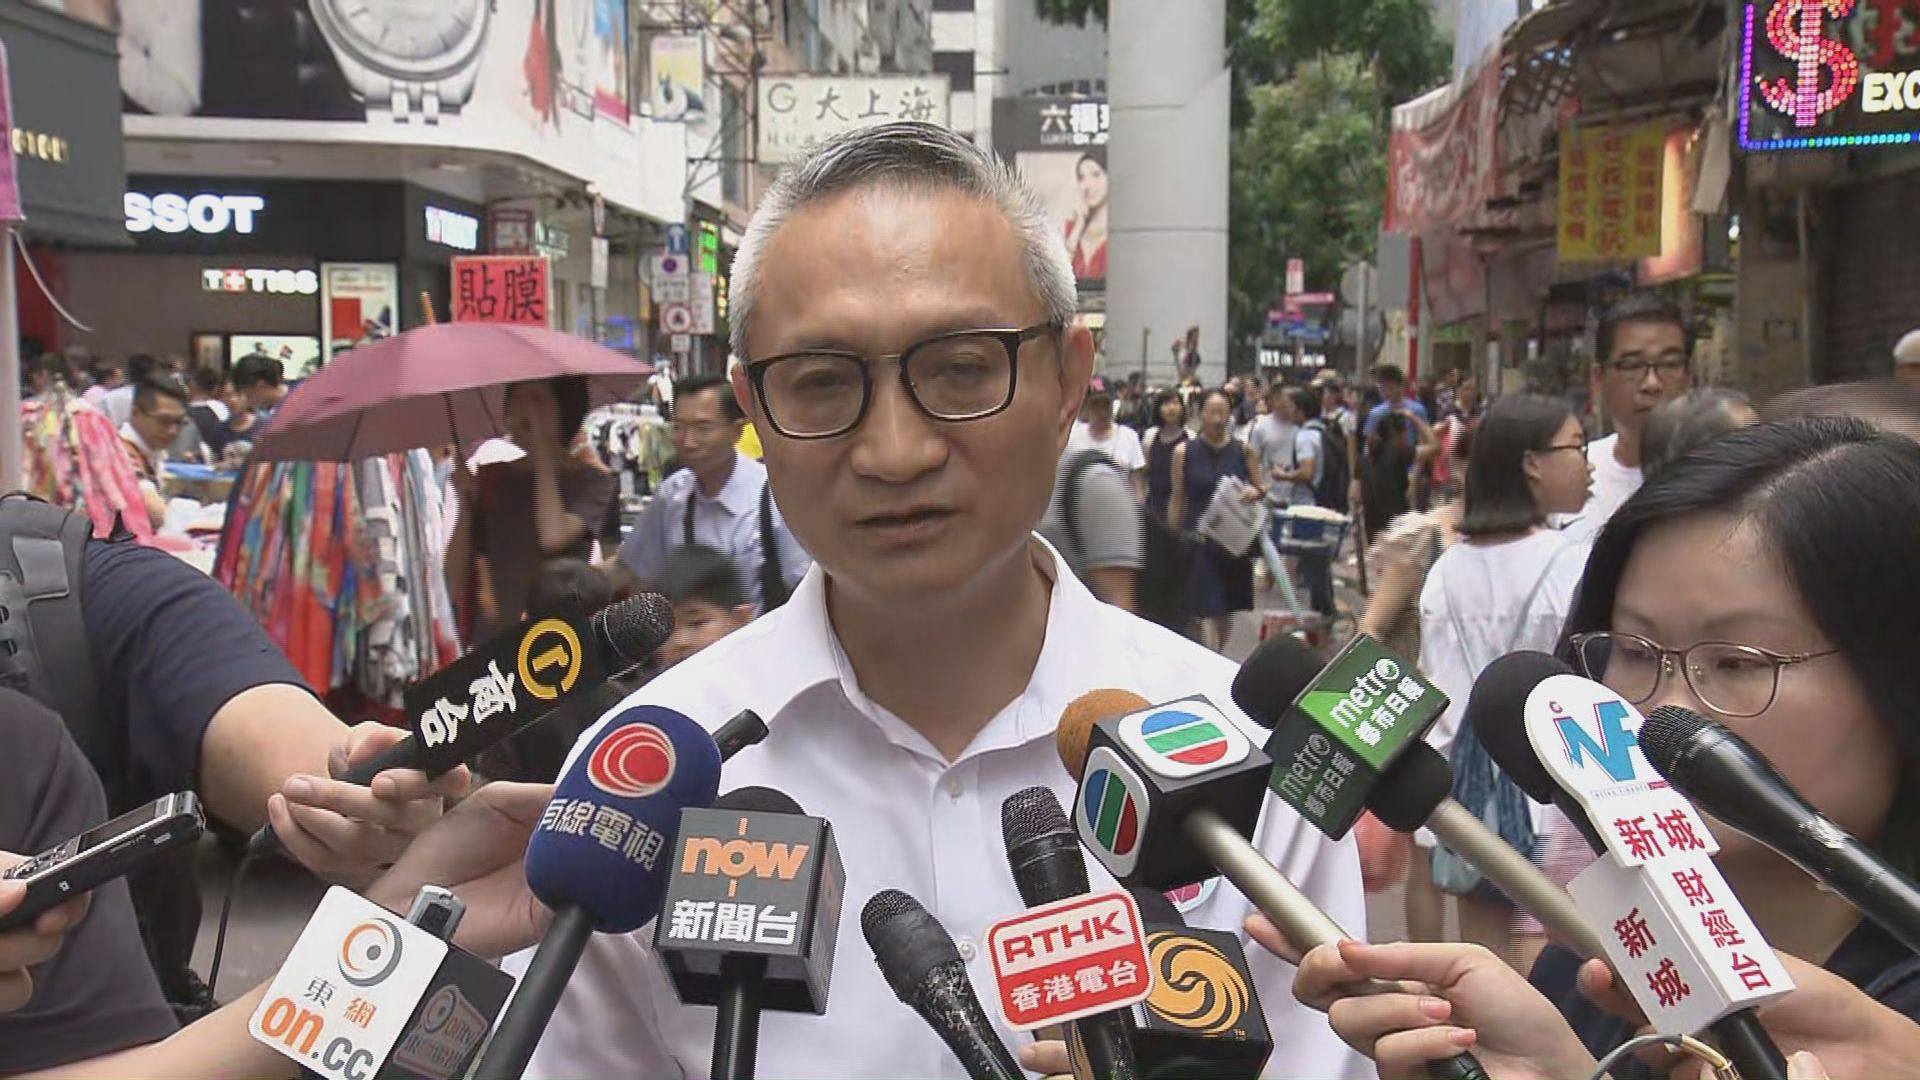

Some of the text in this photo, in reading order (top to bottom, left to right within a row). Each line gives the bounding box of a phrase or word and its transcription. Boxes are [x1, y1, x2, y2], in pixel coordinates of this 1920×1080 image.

[816, 86, 936, 121] 大上海
[1862, 70, 1920, 112] EXC
[458, 262, 543, 321] 貼膜
[1329, 658, 1400, 729] metro
[1280, 734, 1332, 801] metro
[538, 798, 665, 872] 有線電視
[681, 837, 810, 880] now
[1613, 808, 1705, 861] 新城
[668, 899, 799, 945] 新聞台
[1003, 910, 1125, 964] RTHK
[1672, 867, 1771, 991] 財經台
[1614, 906, 1690, 1008] 新城
[1010, 959, 1138, 1013] 香港電台
[261, 997, 374, 1080] on.cc
